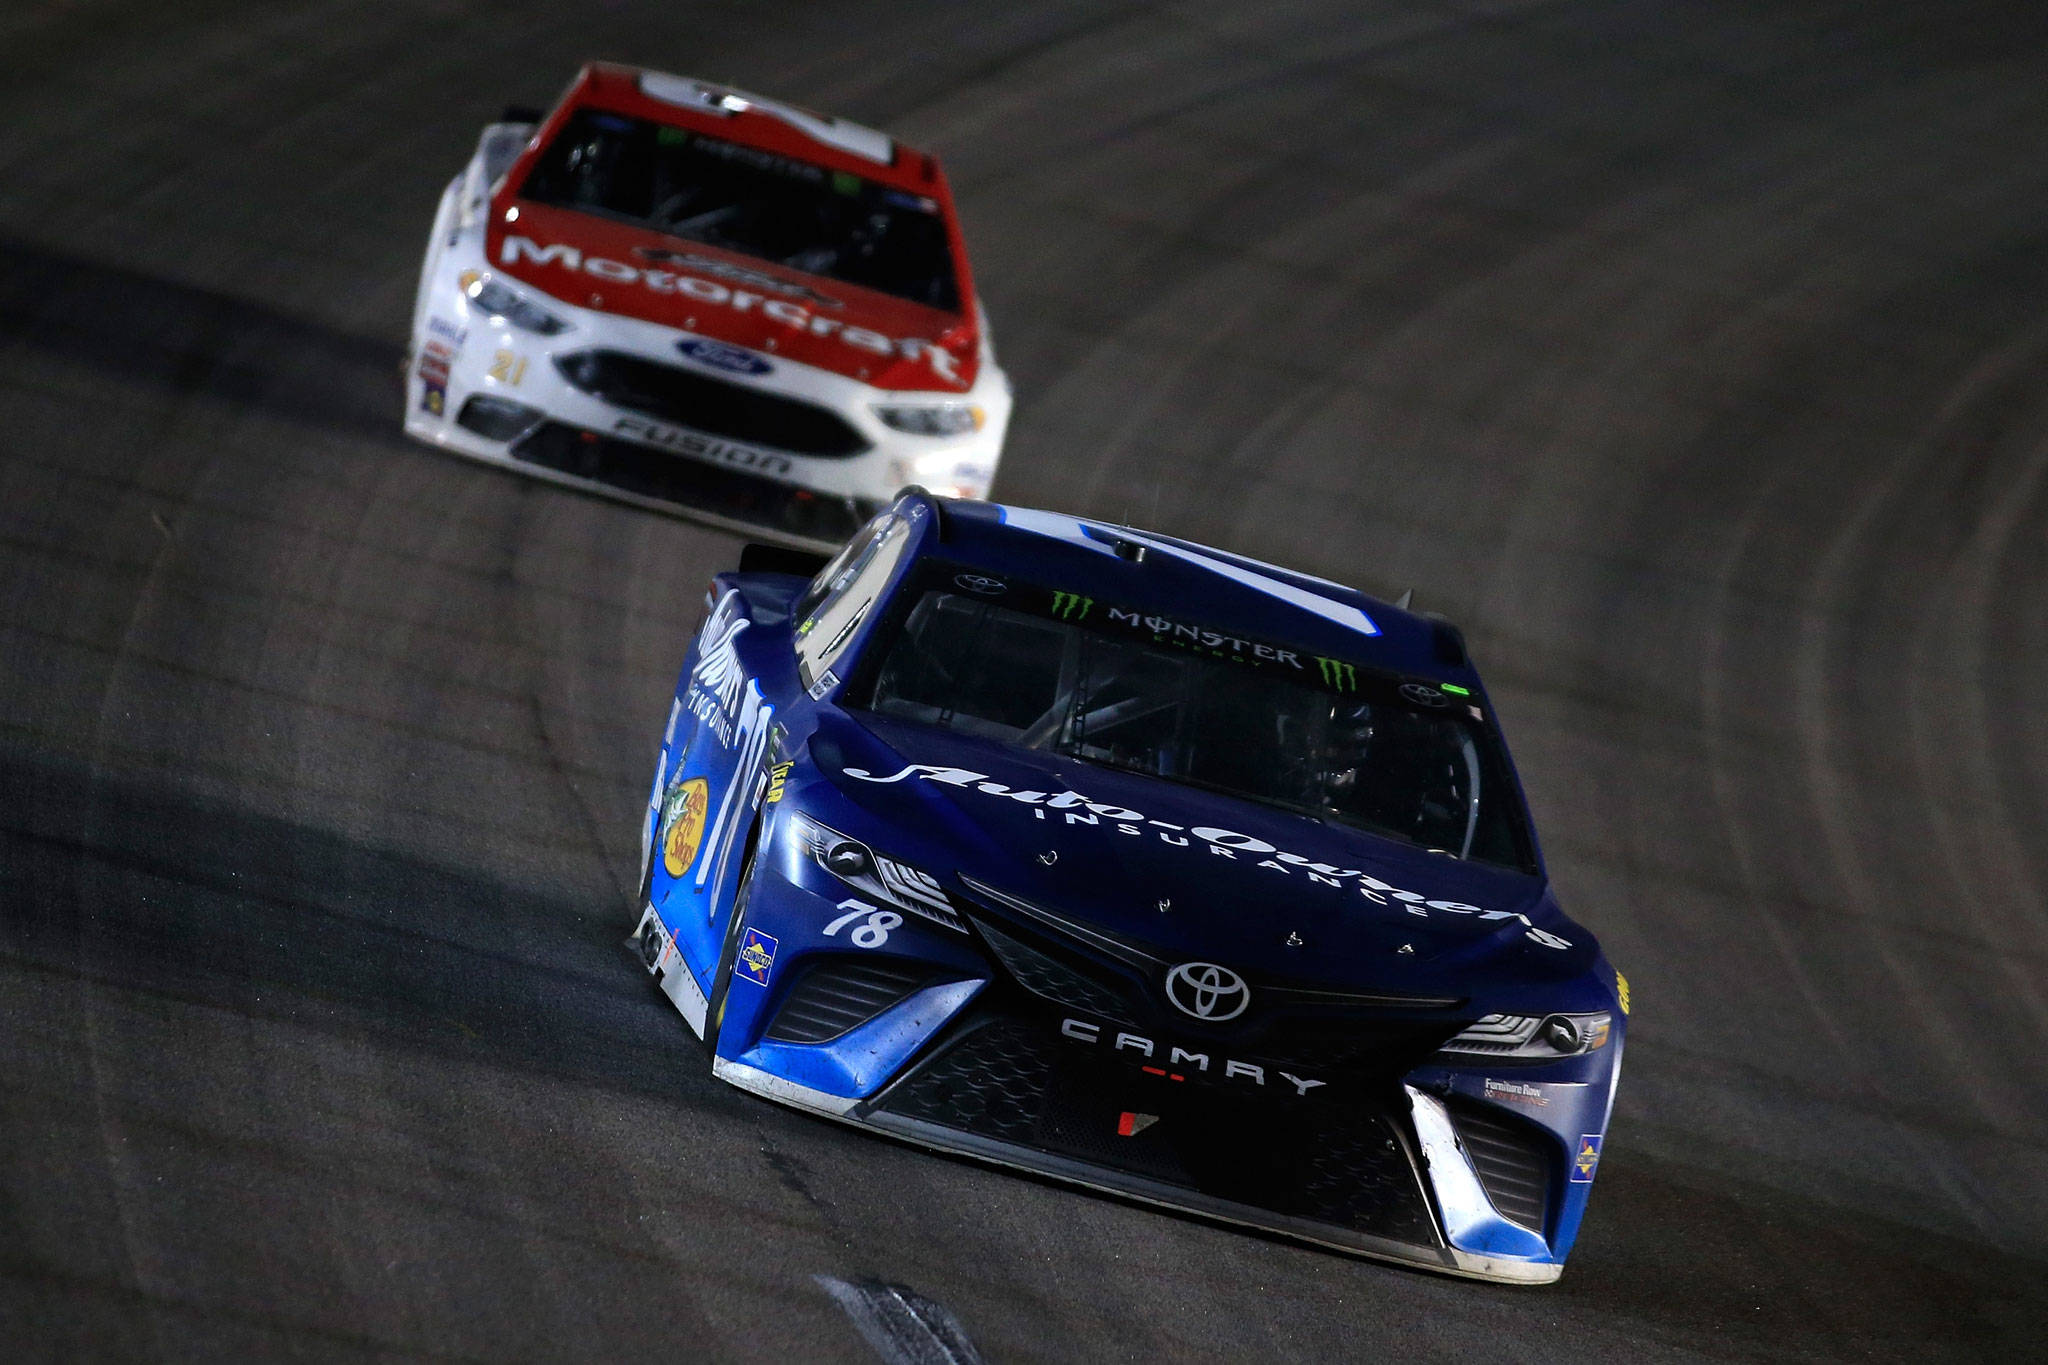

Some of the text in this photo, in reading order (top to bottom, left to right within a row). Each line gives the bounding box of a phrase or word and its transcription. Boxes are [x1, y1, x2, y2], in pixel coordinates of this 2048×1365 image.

[500, 234, 963, 381] Motorcraft
[490, 349, 527, 385] 21
[611, 418, 792, 475] FUSION
[1108, 607, 1304, 669] MONSTER
[1034, 808, 1429, 918] INSURANCE
[823, 899, 903, 949] 78
[1061, 1018, 1328, 1096] CAMRY
[1523, 1084, 1542, 1097] Row
